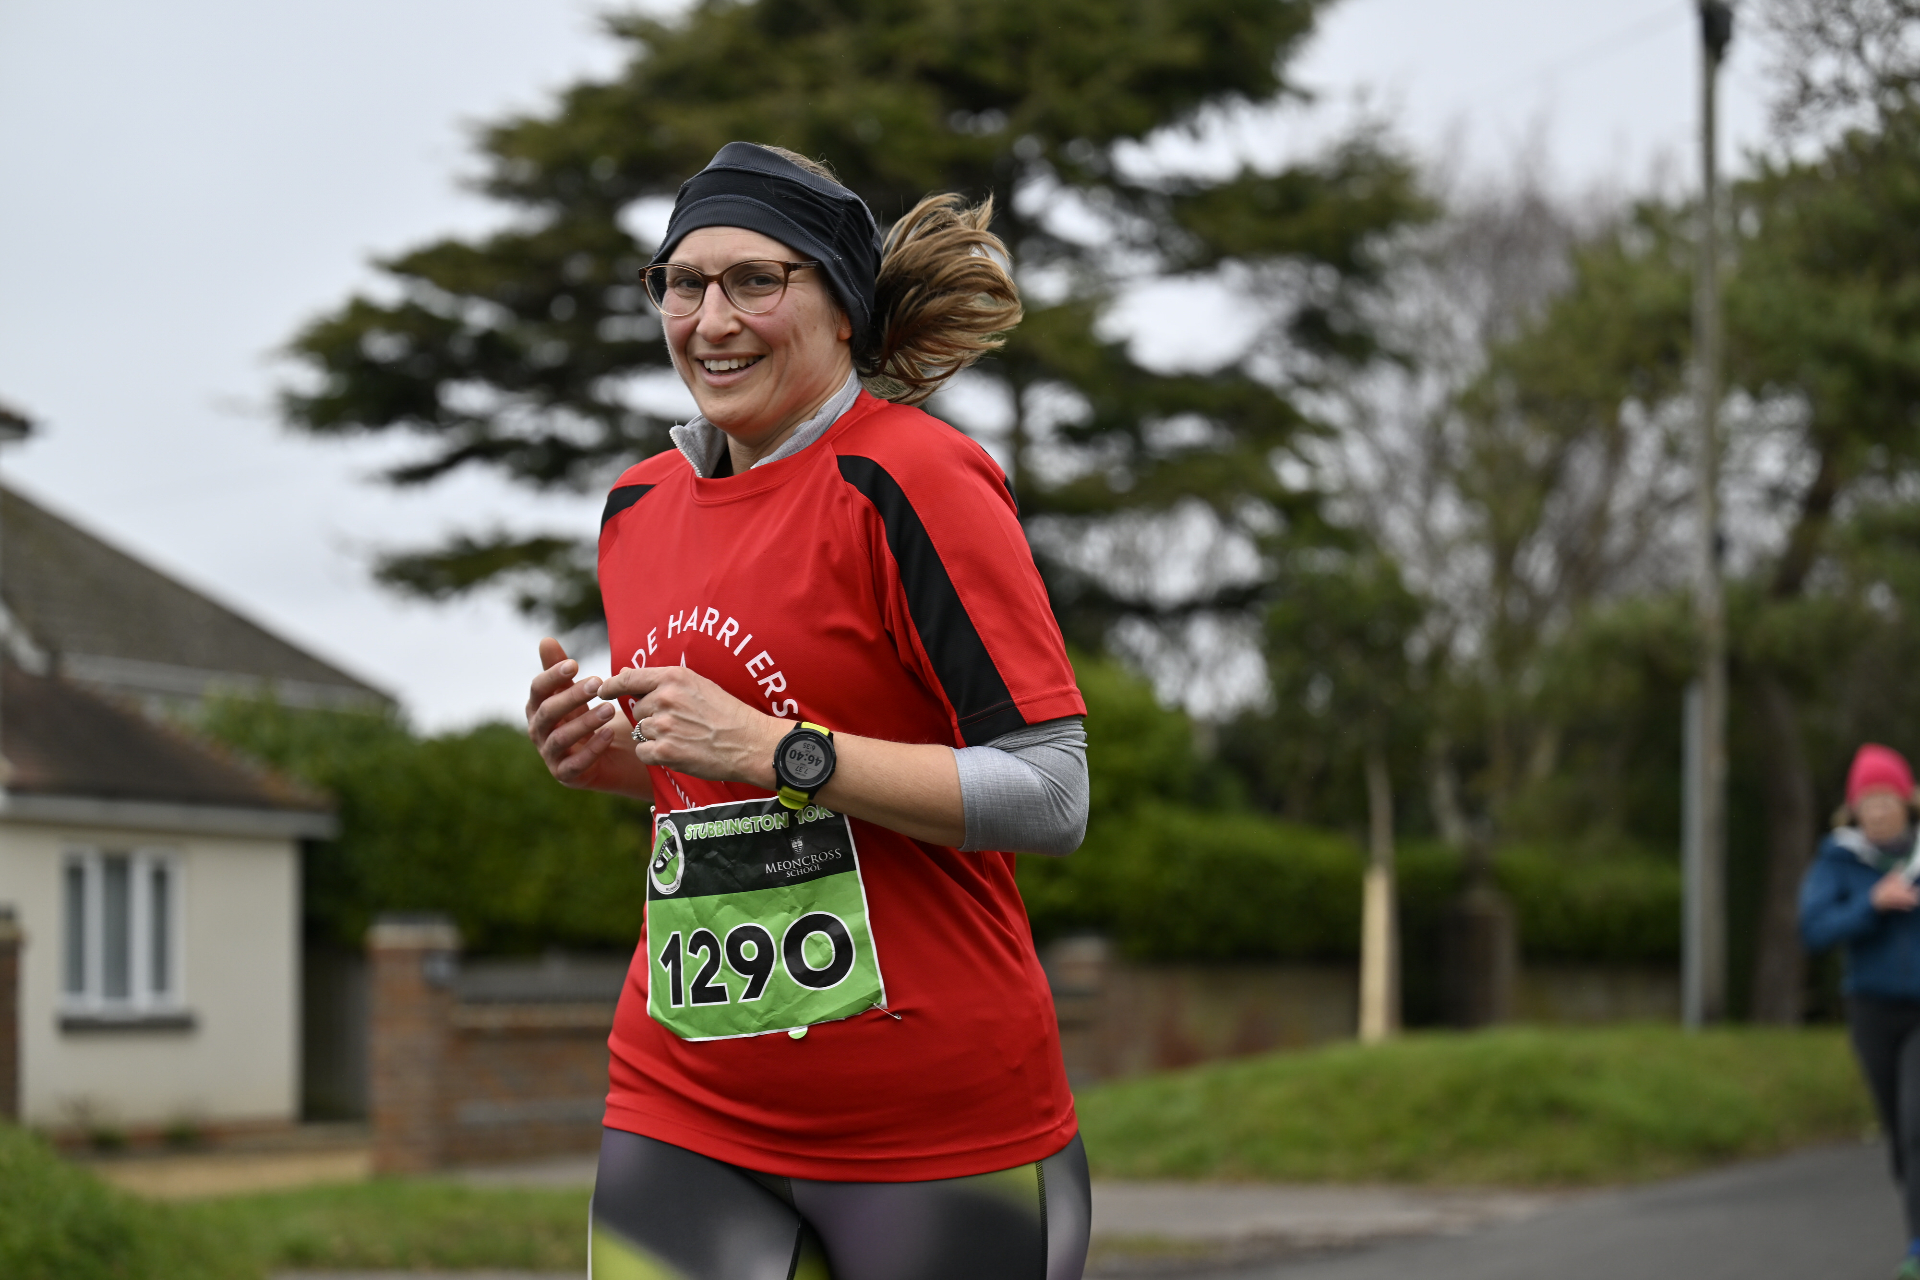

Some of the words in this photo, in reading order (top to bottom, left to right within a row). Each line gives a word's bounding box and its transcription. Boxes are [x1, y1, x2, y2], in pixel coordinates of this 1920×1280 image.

[667, 606, 798, 717] HARRIERS
[789, 749, 822, 766] 46:40
[684, 812, 789, 840] STUBBINGTON
[794, 805, 835, 825] 10K
[765, 848, 842, 874] MEONCROSS
[786, 866, 822, 878] SCHOOL
[658, 911, 856, 1008] 1290
